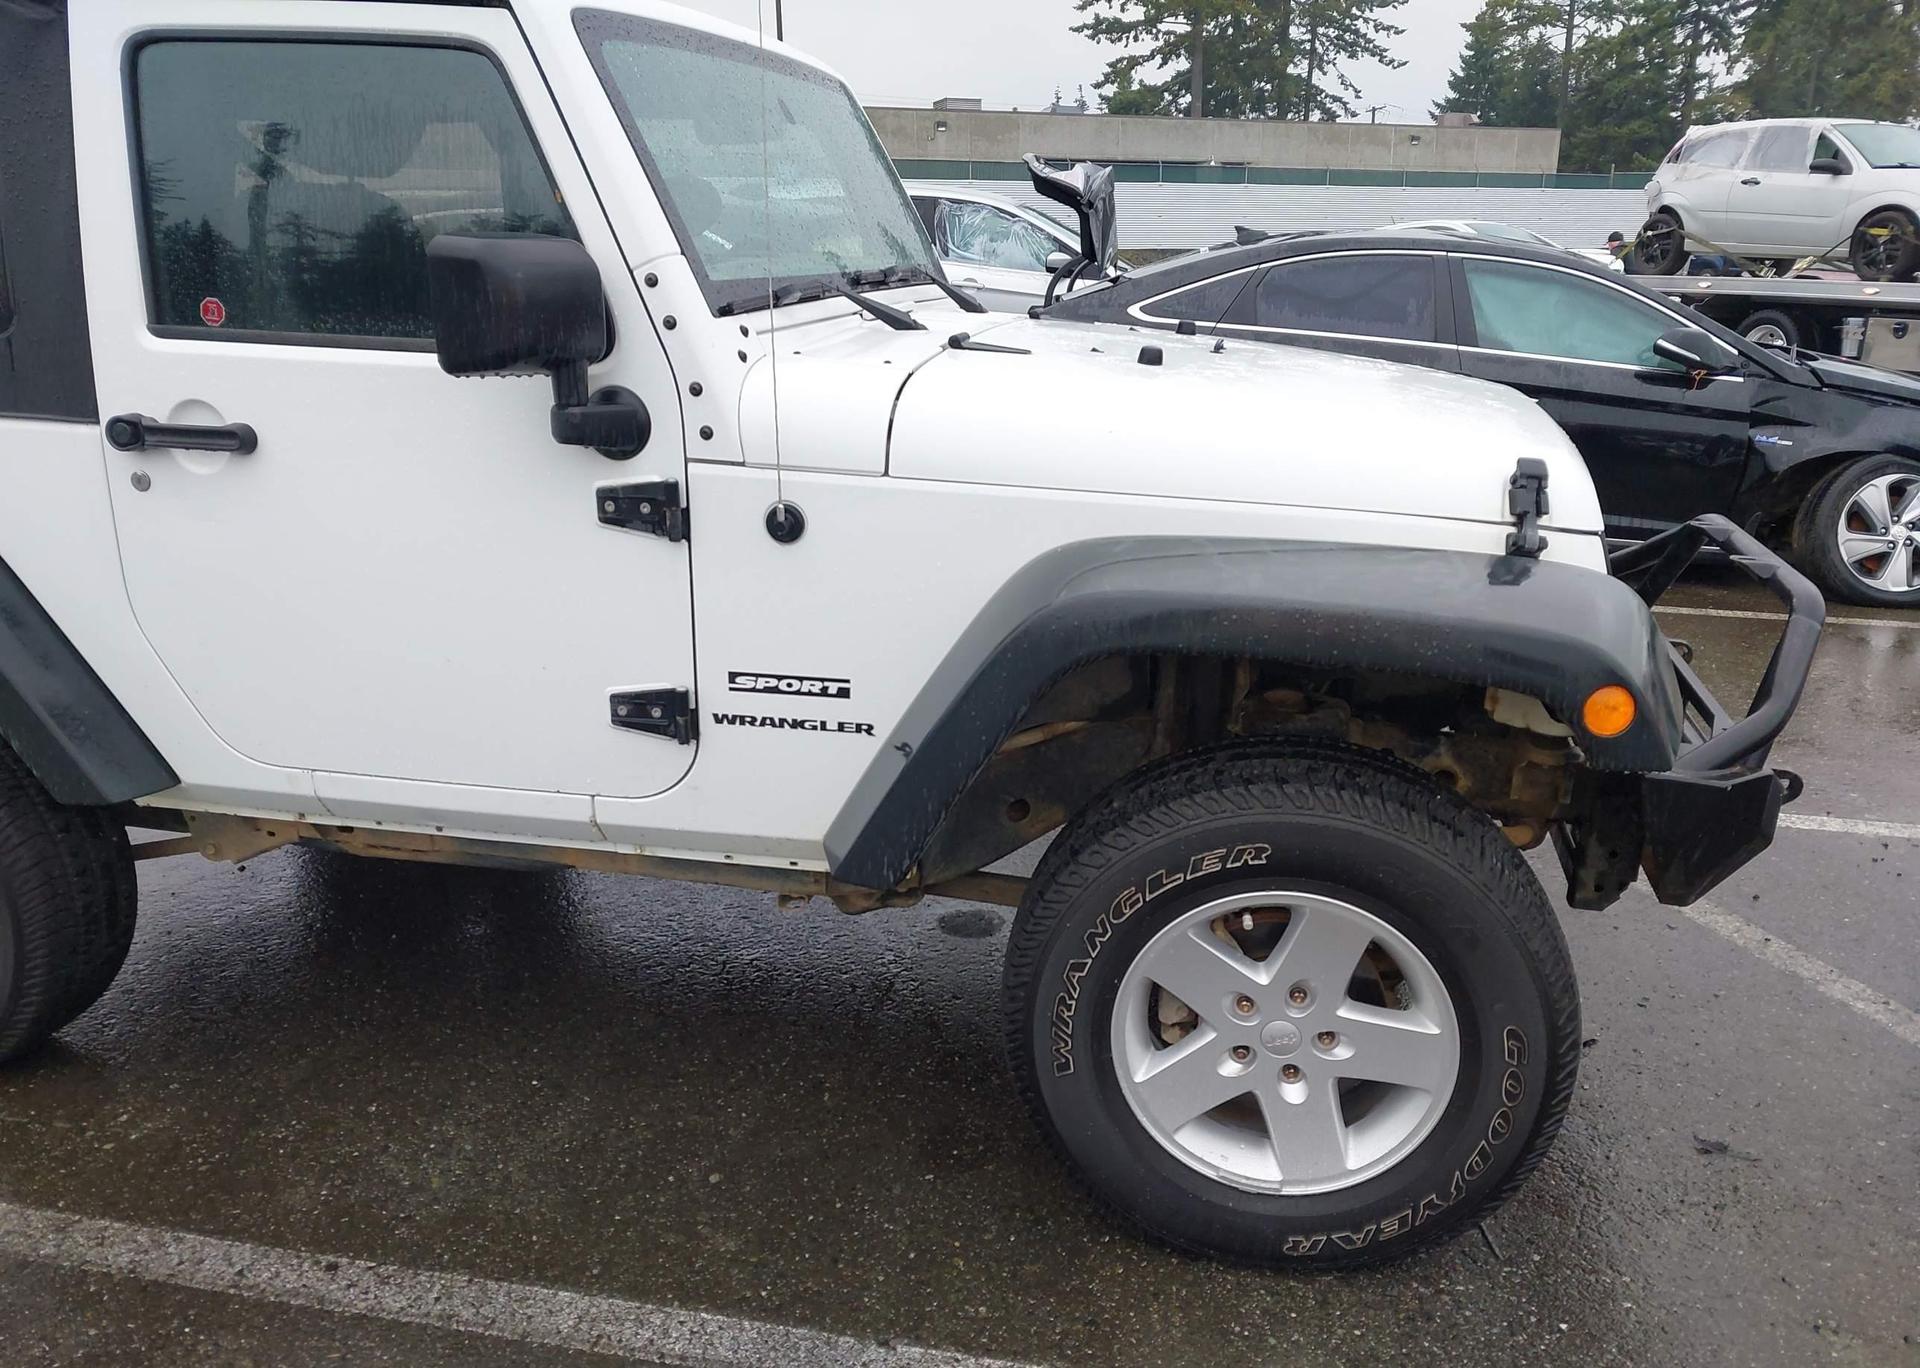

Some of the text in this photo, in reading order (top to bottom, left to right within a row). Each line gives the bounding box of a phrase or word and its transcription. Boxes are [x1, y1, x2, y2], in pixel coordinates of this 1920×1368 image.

[712, 712, 876, 736] WRANGLER
[728, 674, 851, 697] SPORT
[1051, 843, 1272, 1077] WRANGLER
[1283, 1025, 1528, 1256] GOODYEAR
